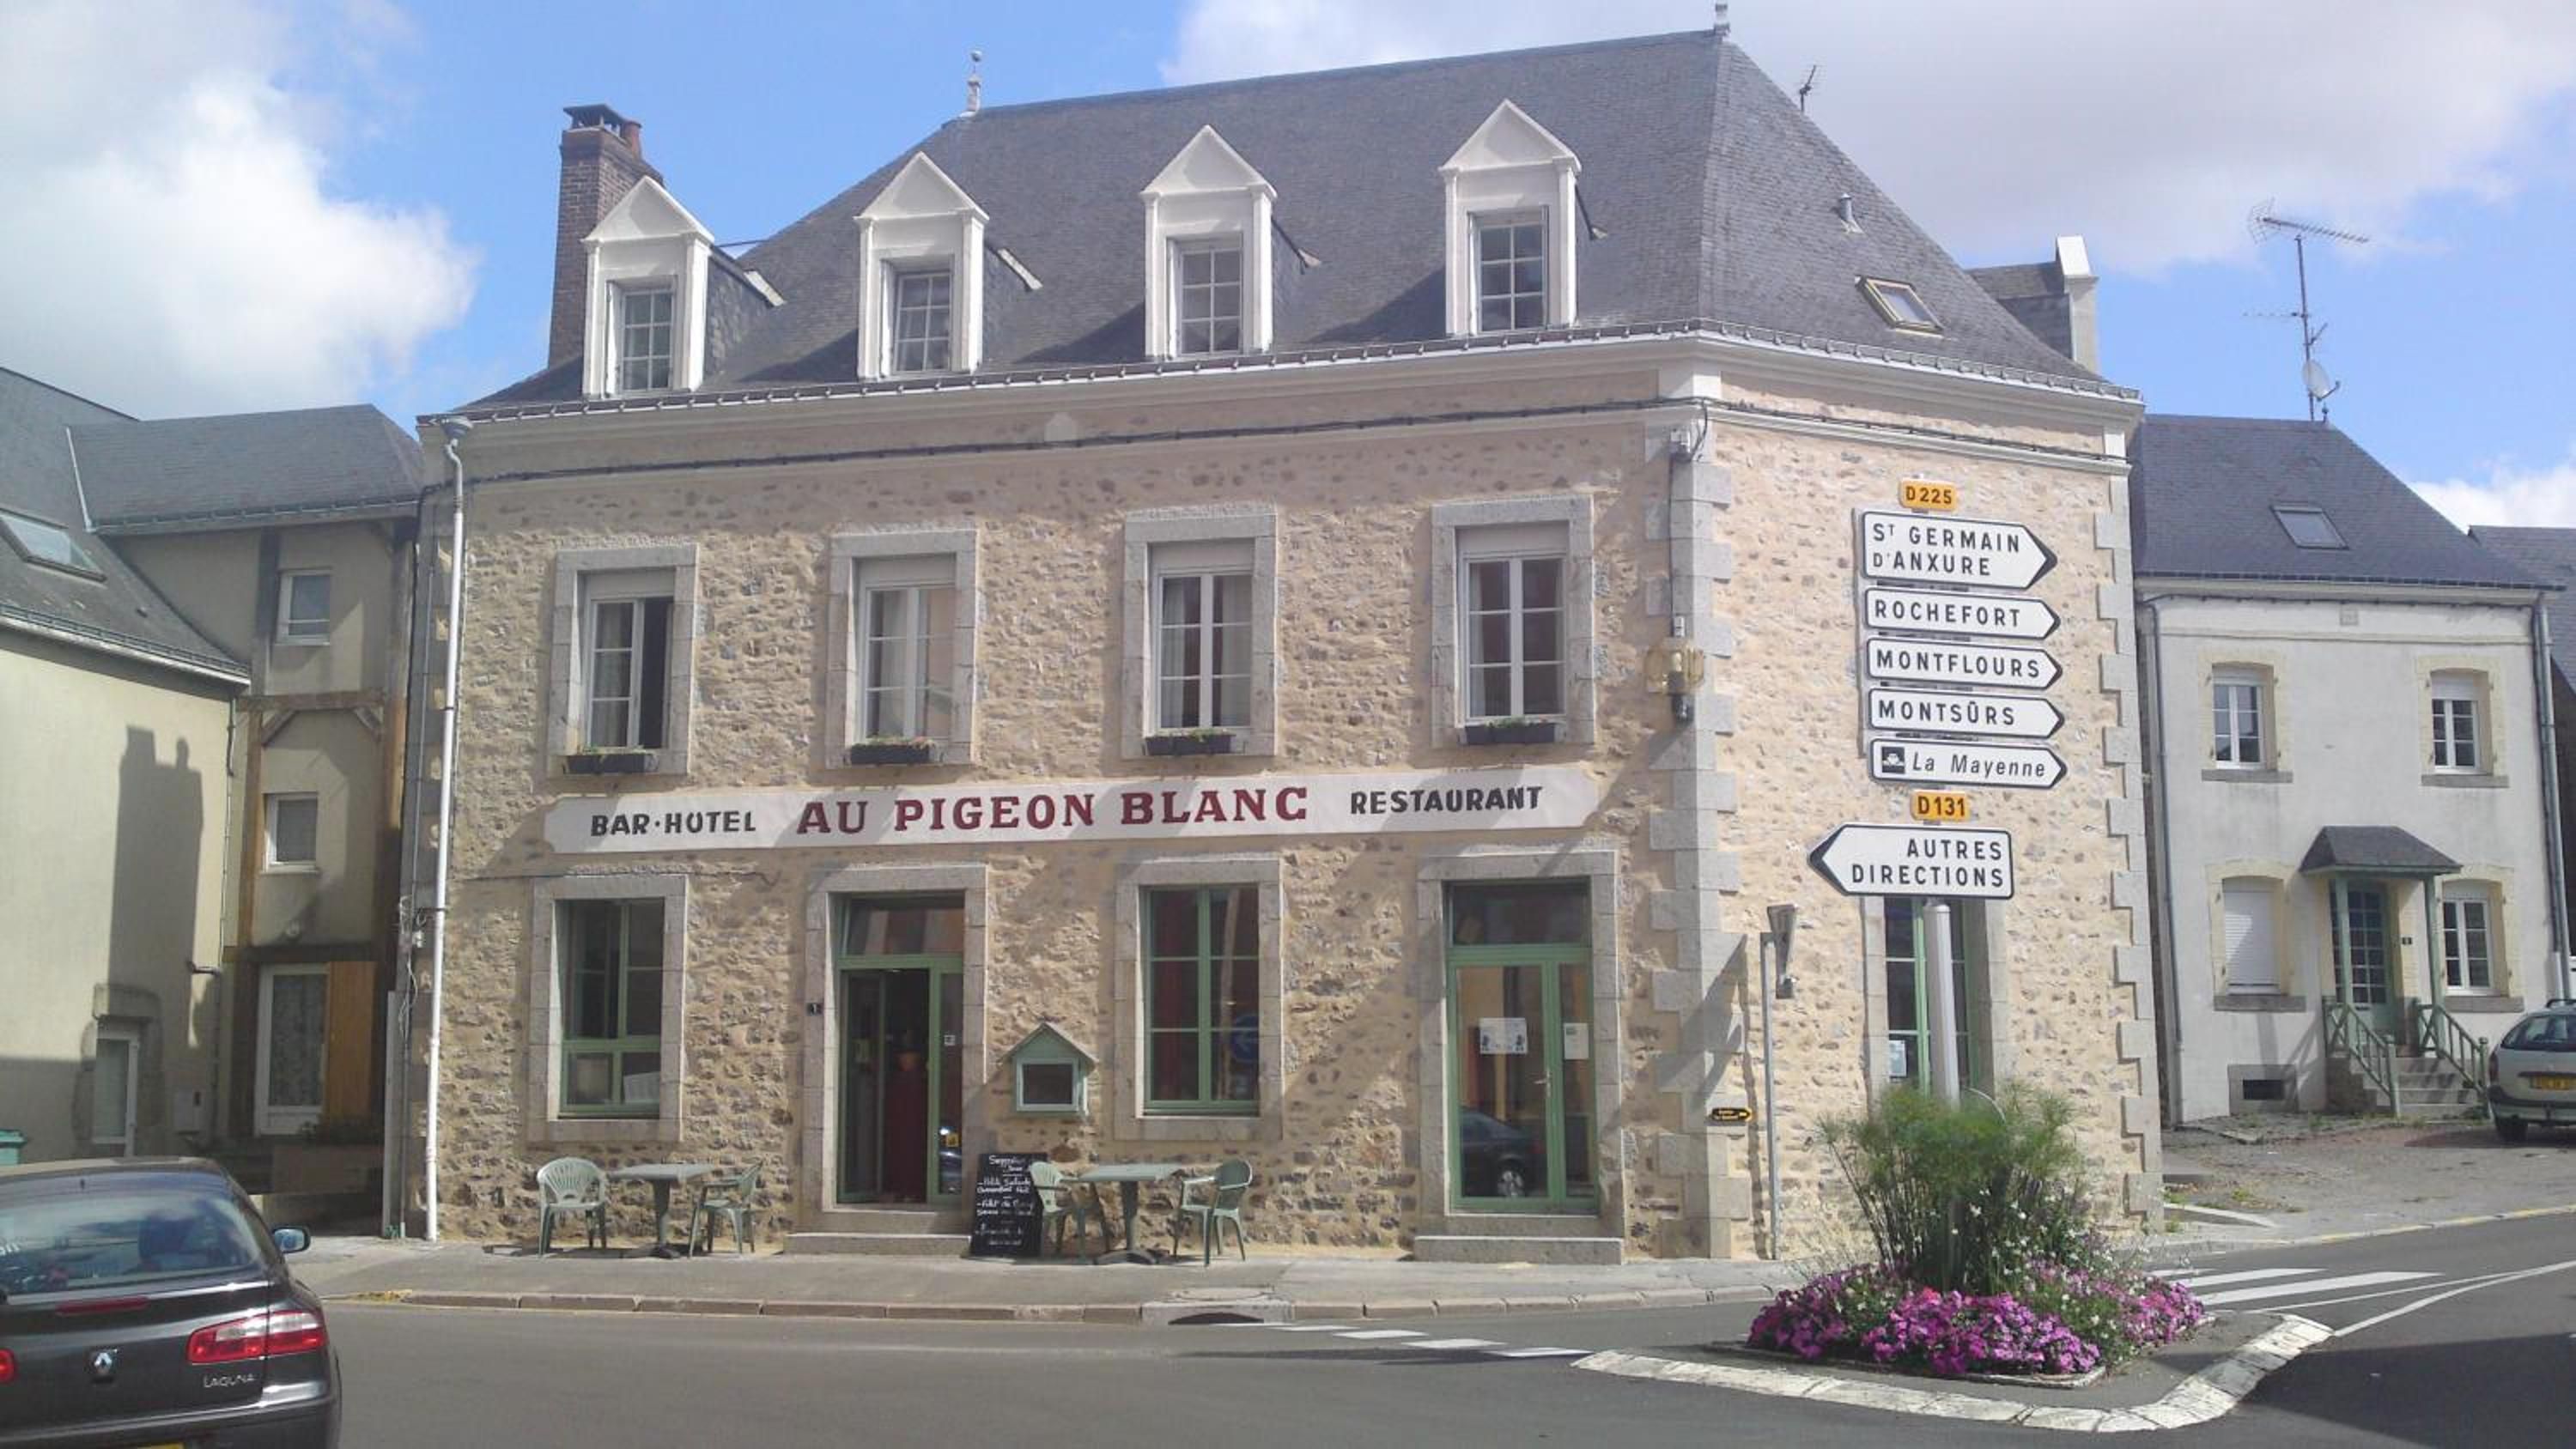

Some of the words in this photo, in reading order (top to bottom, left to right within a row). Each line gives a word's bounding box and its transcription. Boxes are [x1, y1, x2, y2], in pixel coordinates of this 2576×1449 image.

[1905, 485, 1953, 505] D225
[1909, 525, 2020, 553] GERMAIN
[1873, 550, 1991, 576] D'ANXURE
[1874, 599, 2021, 627] ROCHEFORT
[1876, 649, 2040, 678] MONTFLOURS
[1912, 751, 1935, 772] La
[1951, 754, 2046, 779] Mayenne
[796, 800, 868, 835] AU
[894, 792, 1095, 833] PIGEON
[1121, 786, 1308, 825] BLANC
[1351, 785, 1543, 815] RESTAURANT
[1917, 795, 1966, 817] D131
[1906, 838, 2002, 861] AUTRES
[1851, 863, 2004, 888] DIRECTIONS
[203, 1373, 258, 1388] LAGUNA
